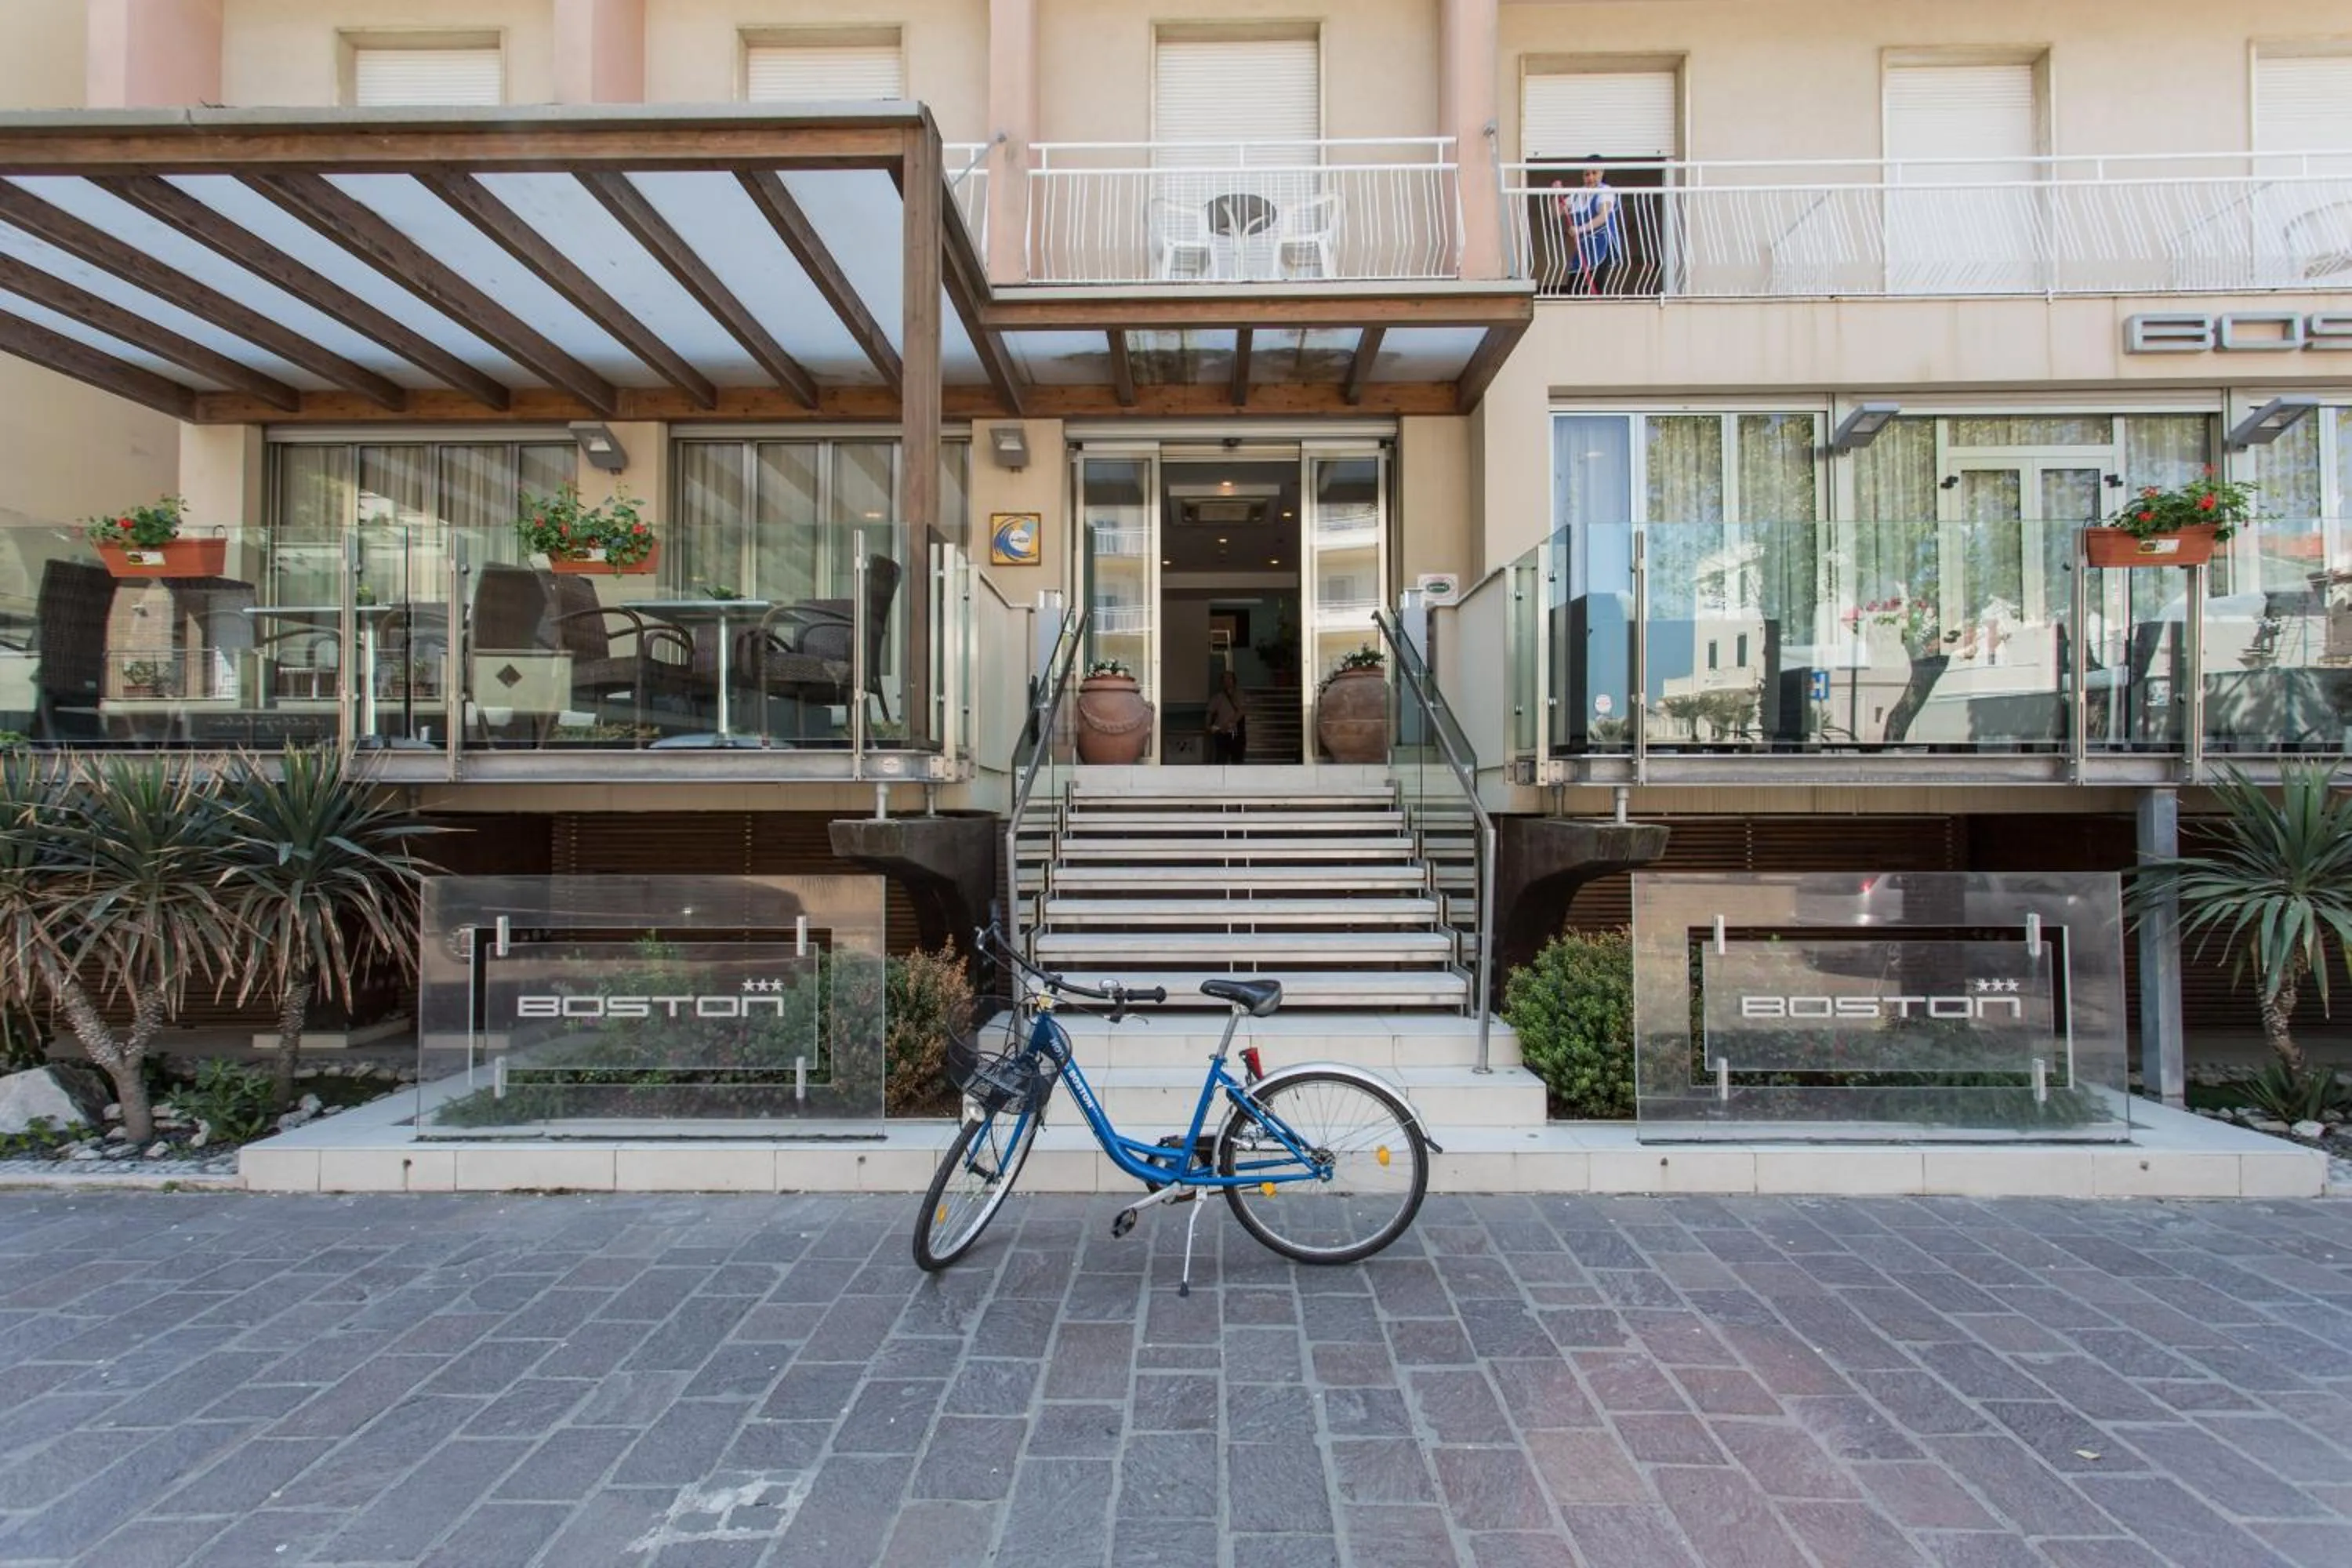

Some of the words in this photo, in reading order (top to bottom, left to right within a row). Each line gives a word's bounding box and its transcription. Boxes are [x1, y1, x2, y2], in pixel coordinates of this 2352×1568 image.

[517, 995, 784, 1017] BOSTON
[1741, 996, 2021, 1018] BOSTON
[1066, 1068, 1094, 1109] BOSTON
